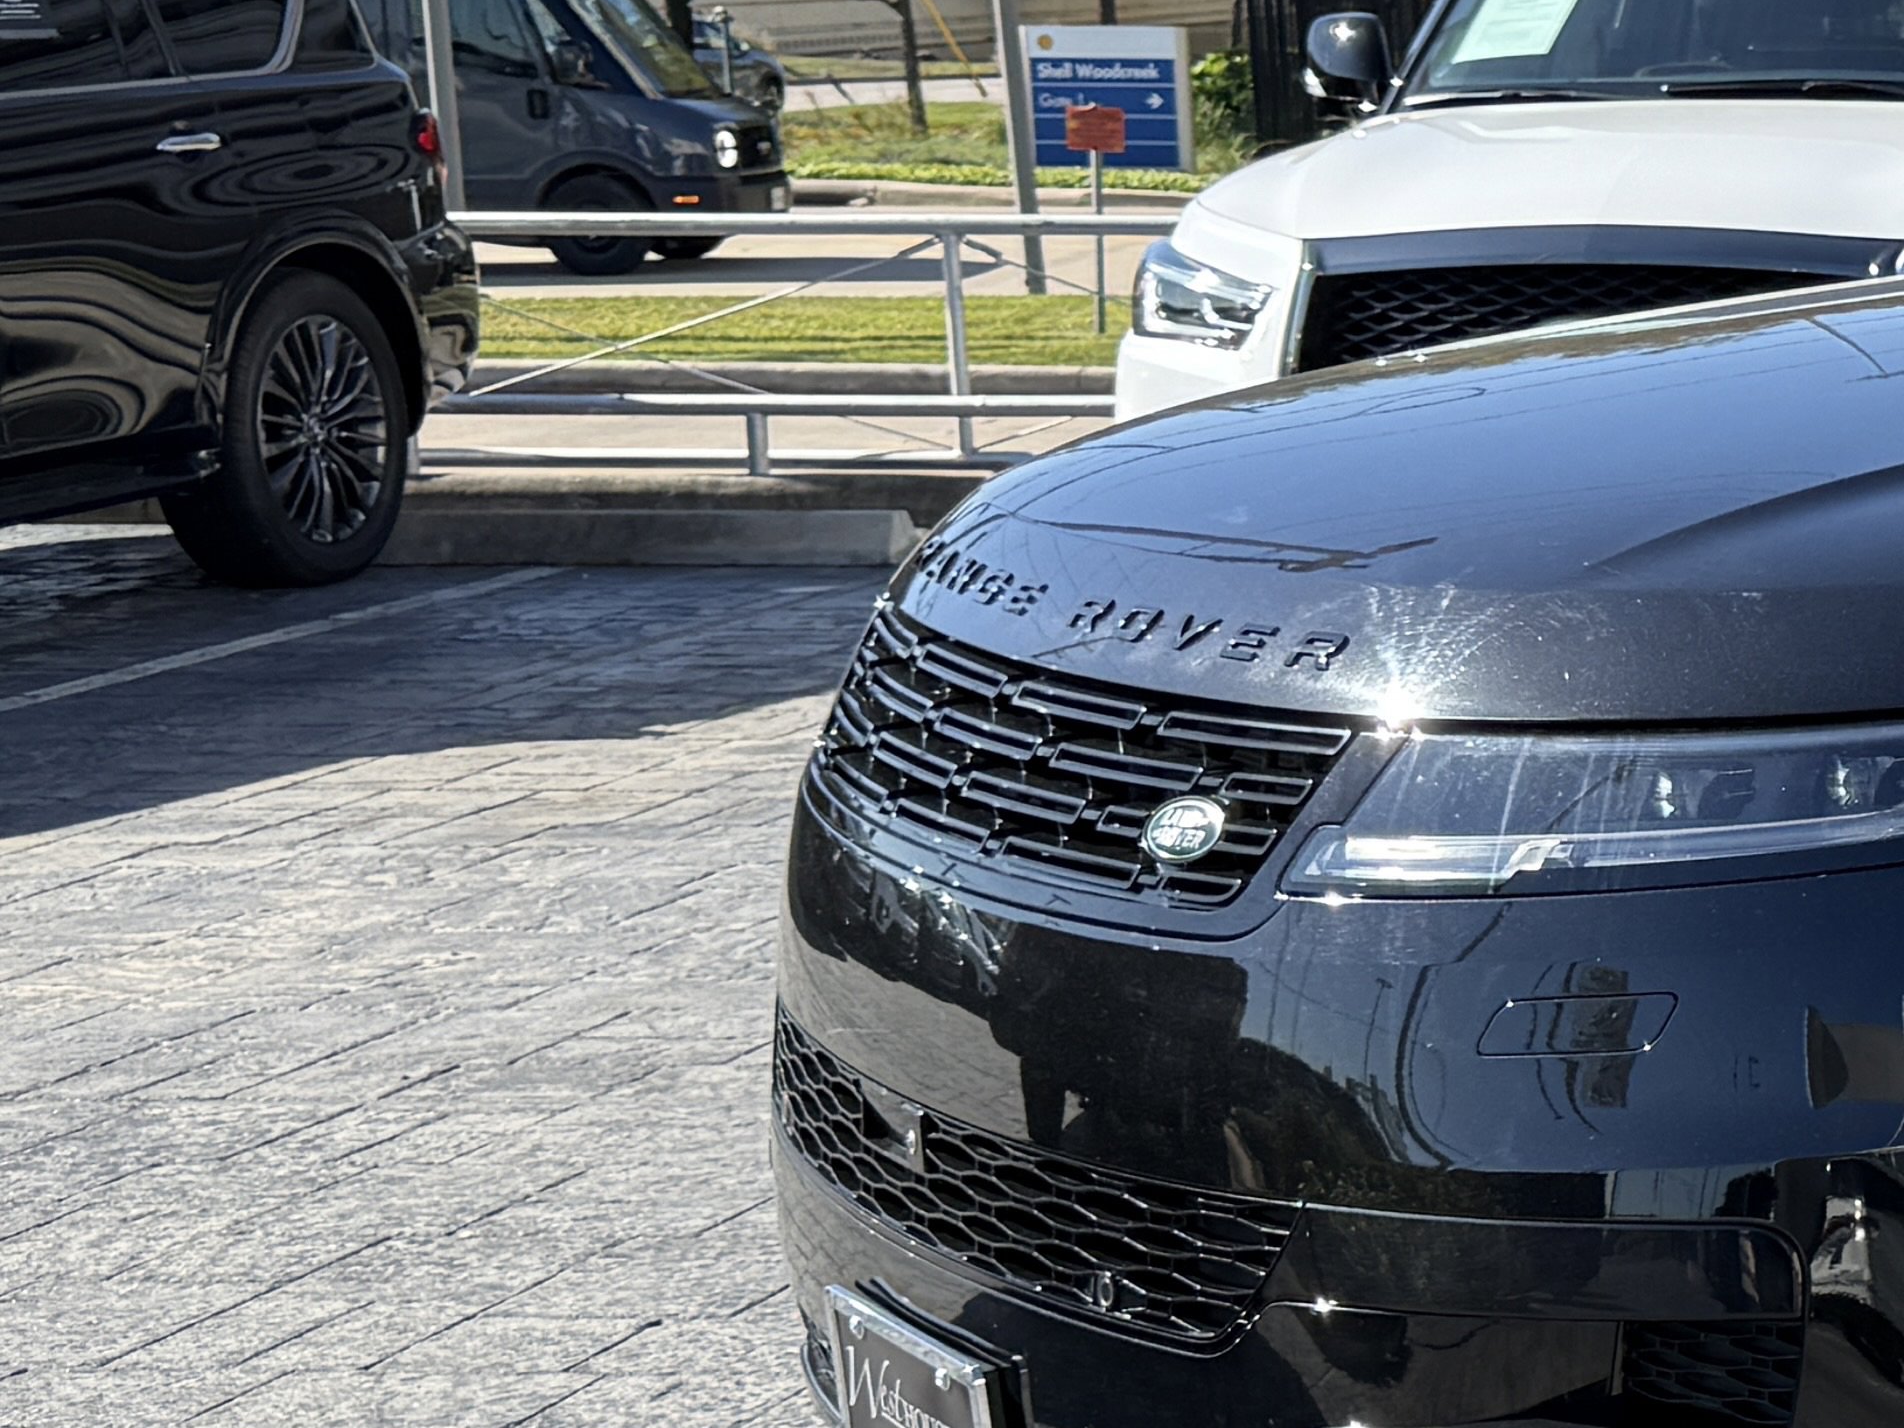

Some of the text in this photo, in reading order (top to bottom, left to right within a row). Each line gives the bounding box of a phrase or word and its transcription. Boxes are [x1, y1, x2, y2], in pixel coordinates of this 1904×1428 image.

[1037, 62, 1160, 80] Shell Woodcreek
[917, 535, 1351, 672] RANGE ROVER
[846, 1345, 904, 1420] West
